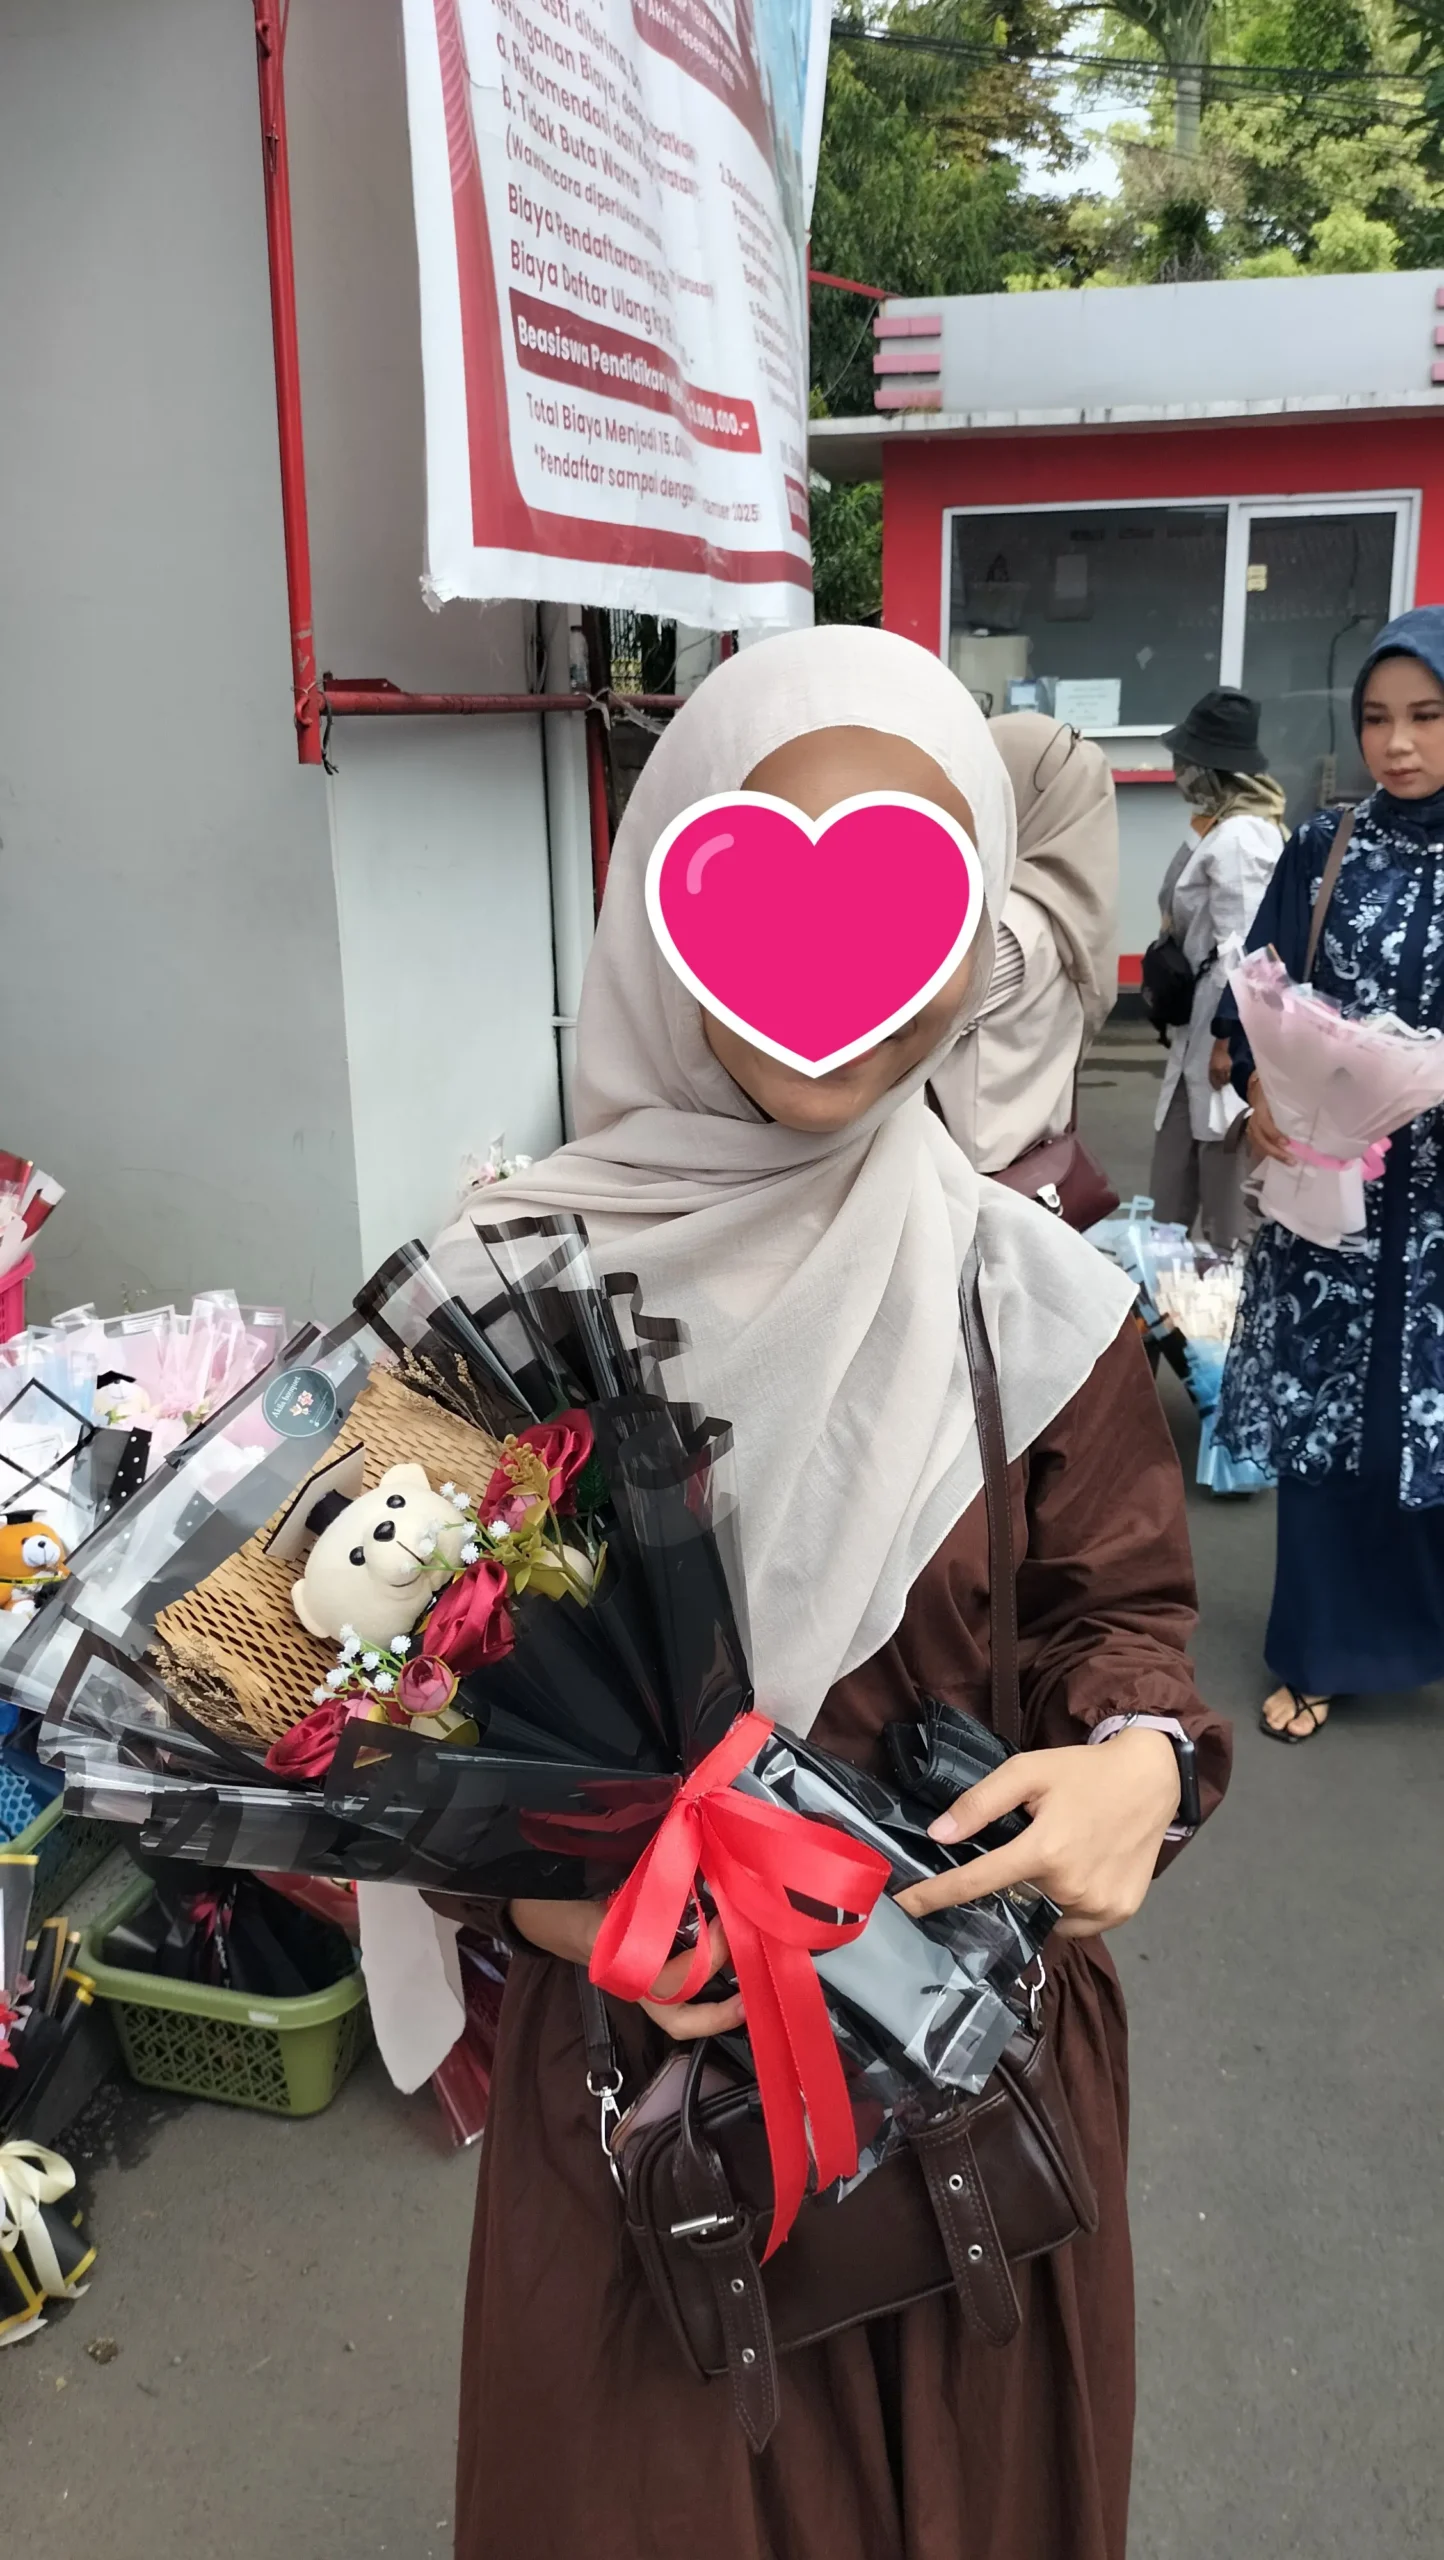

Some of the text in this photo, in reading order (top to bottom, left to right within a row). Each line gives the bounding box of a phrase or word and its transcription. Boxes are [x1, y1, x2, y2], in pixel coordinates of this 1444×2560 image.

[501, 74, 517, 115] b.
[517, 90, 558, 148] Tidak
[559, 123, 597, 169] Buta
[600, 147, 641, 199] Warna
[512, 40, 611, 138] Rekomendasi
[508, 182, 554, 238] Biaya
[555, 211, 642, 279] Pendaftaran
[510, 239, 558, 292] Biaya
[562, 263, 607, 309] Daftar
[611, 286, 652, 336] Ulang
[517, 315, 590, 368] Beasiswa
[591, 343, 668, 395] Pendidikan
[526, 392, 559, 428] Total
[562, 403, 601, 444] Biaya
[605, 417, 656, 456] Menjadi
[608, 465, 658, 499] sampai
